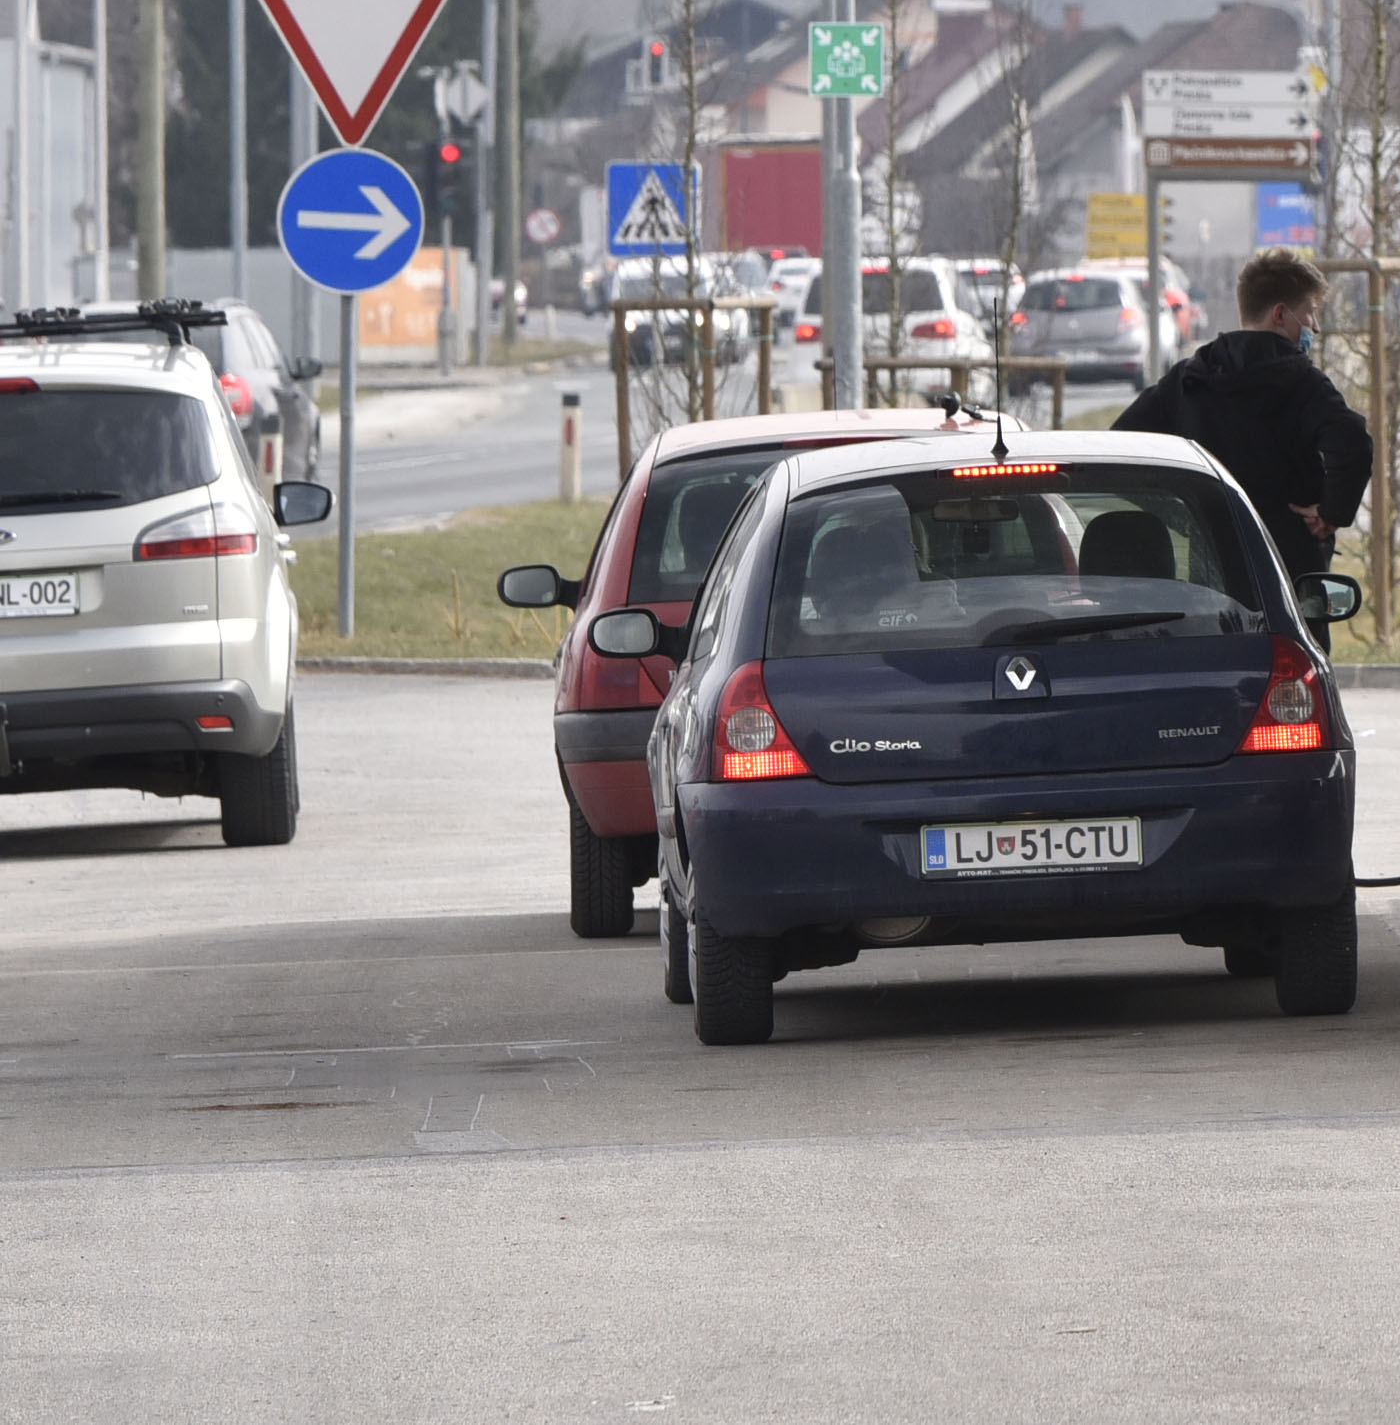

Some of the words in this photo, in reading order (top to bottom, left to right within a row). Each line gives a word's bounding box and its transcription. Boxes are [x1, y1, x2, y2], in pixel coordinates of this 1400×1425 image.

[878, 614, 904, 627] elf
[1158, 725, 1221, 739] RENAULT
[830, 738, 871, 754] Clio
[874, 739, 922, 752] Storia
[955, 830, 993, 864] LJ
[1020, 825, 1129, 861] 51-CTU
[929, 855, 944, 865] SLO
